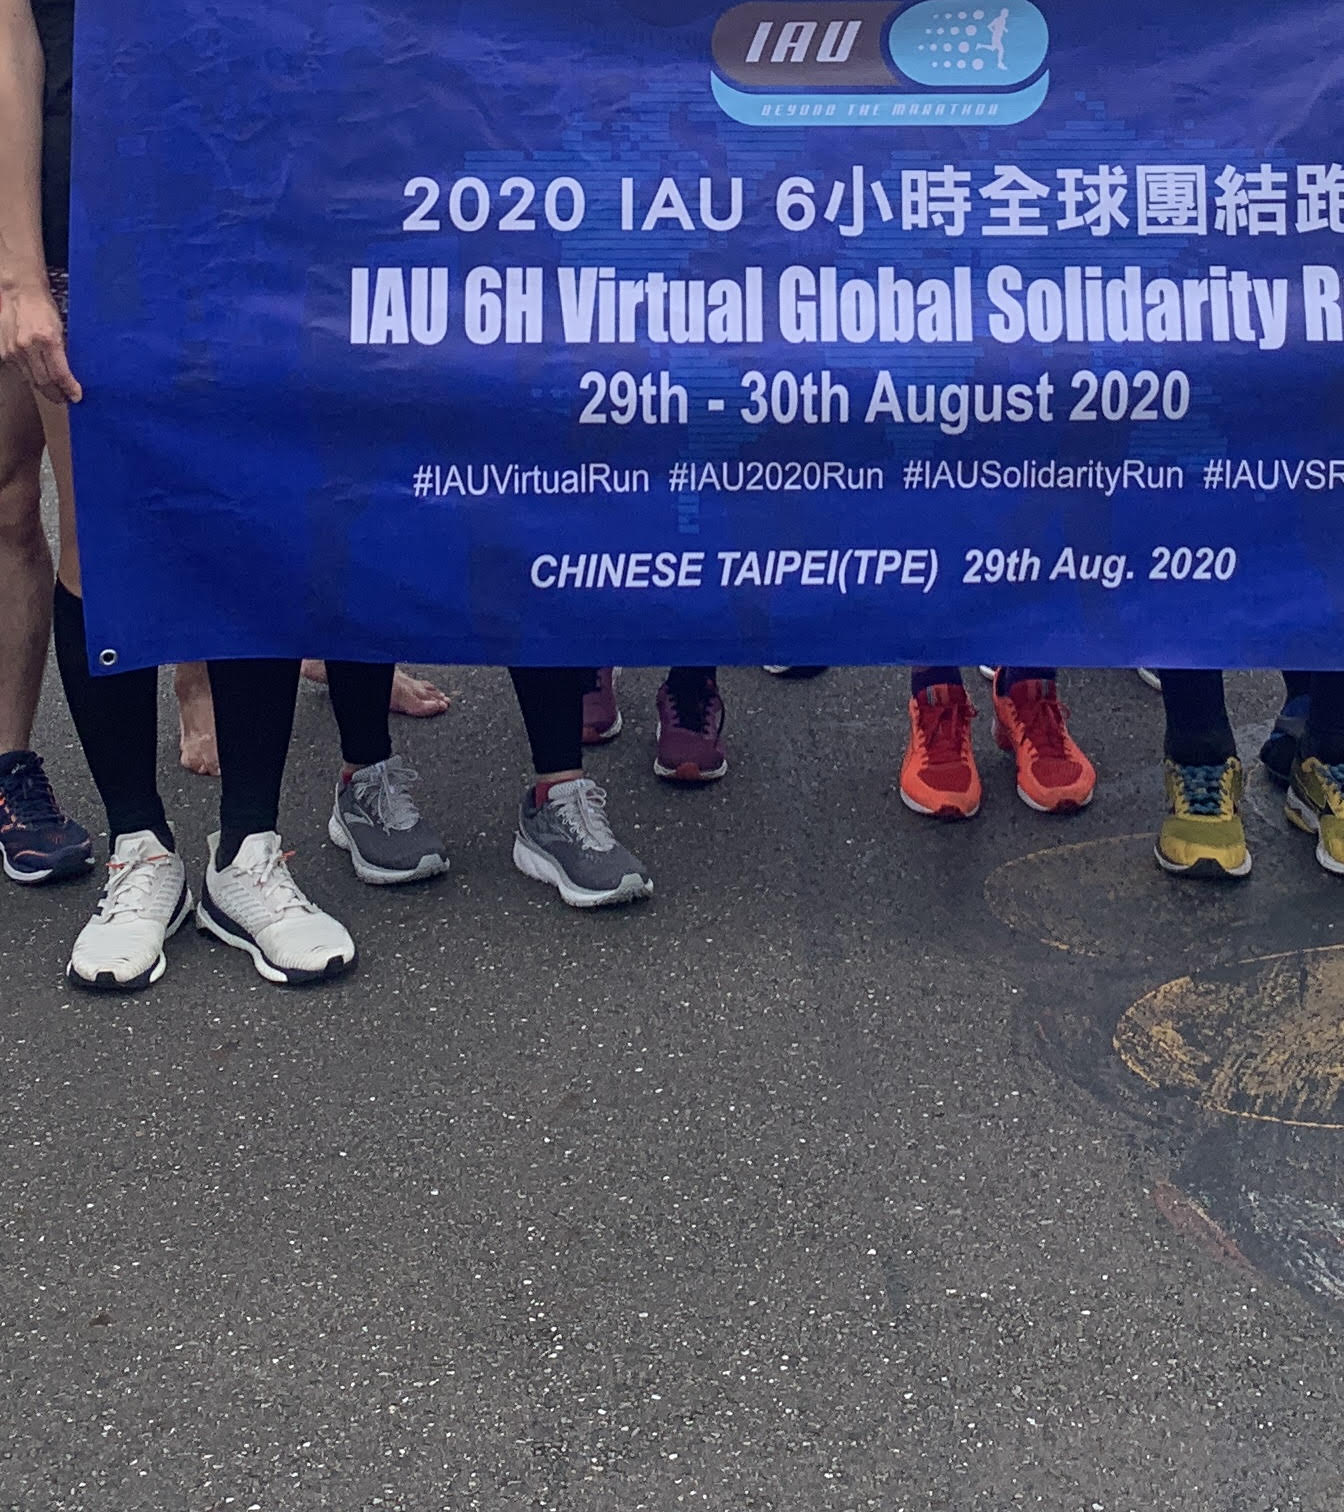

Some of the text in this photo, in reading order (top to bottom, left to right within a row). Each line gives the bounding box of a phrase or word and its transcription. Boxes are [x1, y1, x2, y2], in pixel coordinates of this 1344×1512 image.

[745, 20, 862, 63] IAU
[760, 103, 1000, 117] BEYOND THE MARATHON
[402, 176, 586, 232] 2020
[621, 177, 743, 232] IAU
[350, 267, 449, 345] IAU
[464, 265, 543, 345] 6H
[557, 266, 764, 344] Virtual
[778, 265, 974, 344] Global
[987, 265, 1288, 350] Solidarity
[578, 369, 1190, 435] 29th - 30th August 2020
[412, 463, 649, 498] #IAUVirtualRun
[668, 461, 883, 492] #IAU2020Run
[903, 459, 1184, 497] #IAUSolidarityRun
[530, 546, 1237, 594] CHINESE TAIPEI(TPE) 29th Aug. 2020
